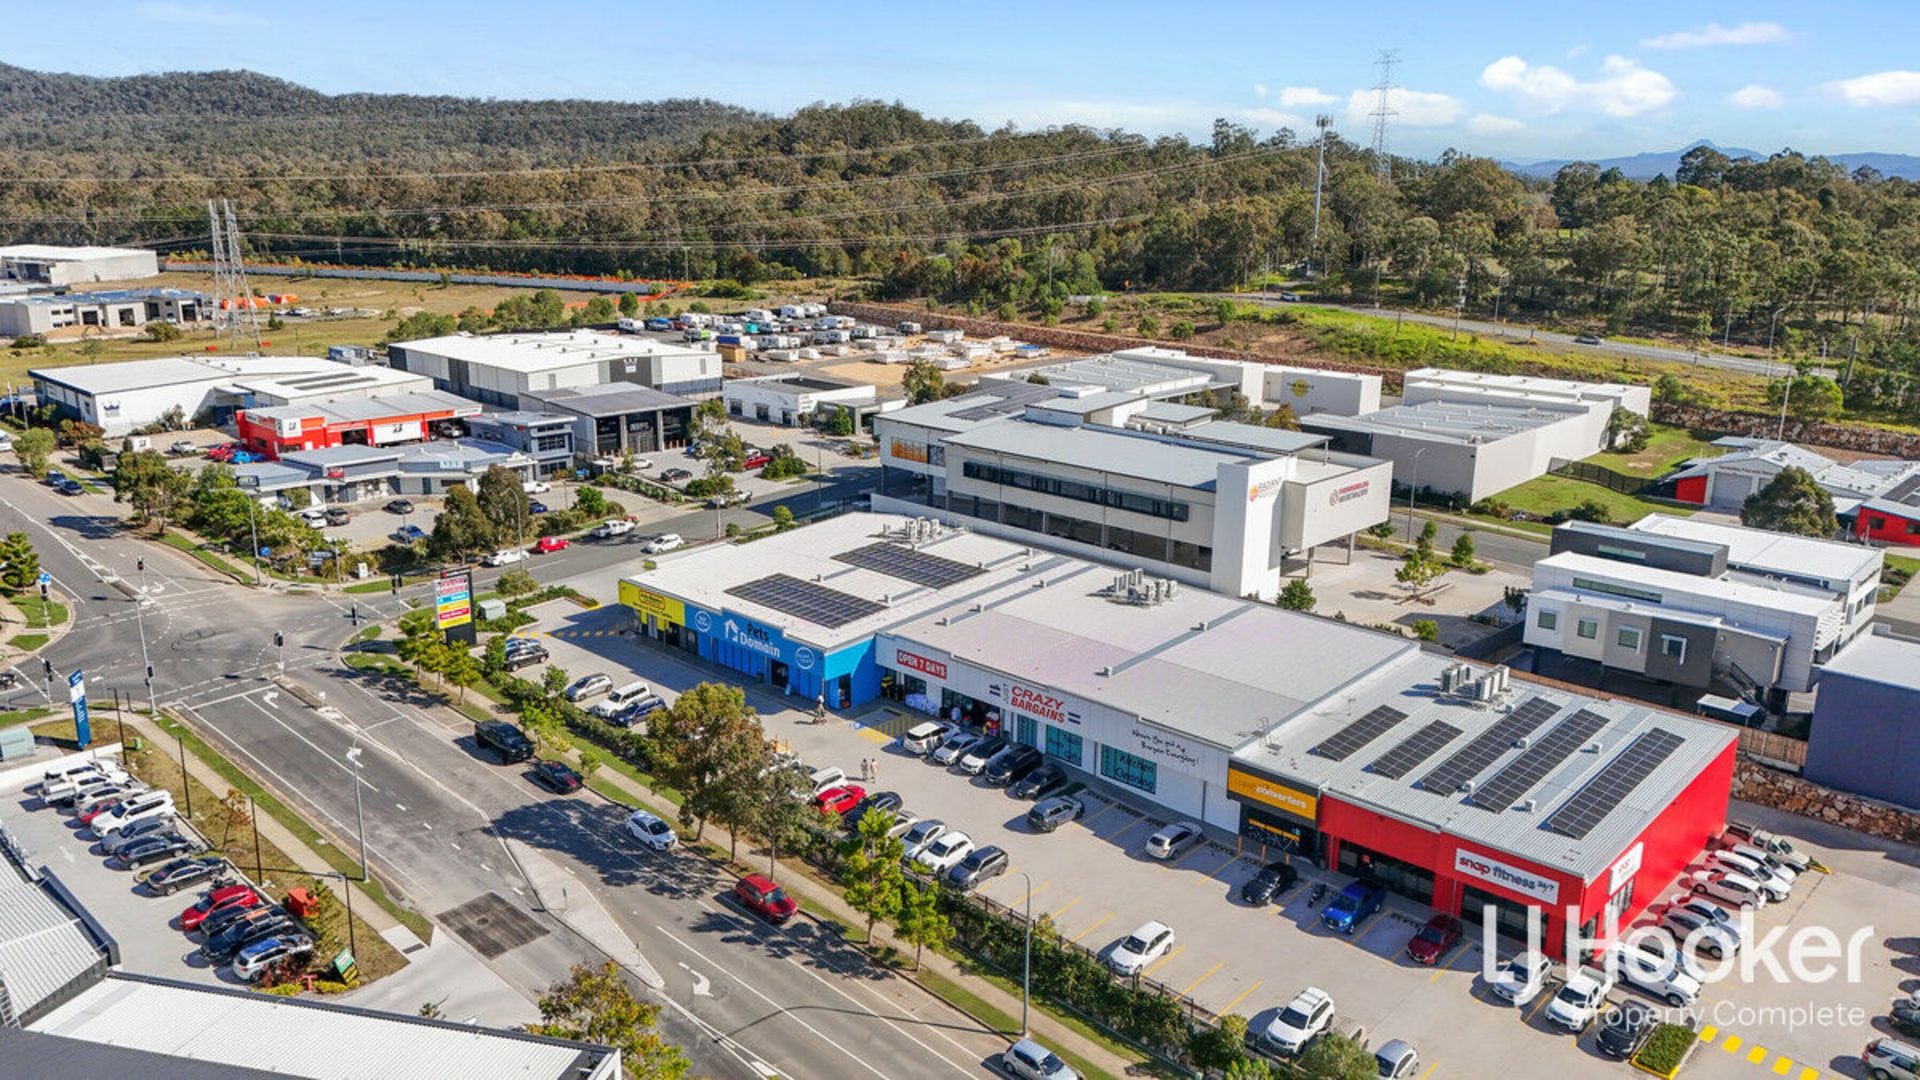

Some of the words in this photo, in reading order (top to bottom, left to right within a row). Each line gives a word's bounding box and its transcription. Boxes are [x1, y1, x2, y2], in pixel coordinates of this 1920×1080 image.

[740, 632, 780, 658] Domain
[747, 622, 769, 642] Pets
[898, 651, 918, 668] OPEN
[919, 658, 925, 669] 7
[926, 660, 946, 677] DAYS
[1011, 686, 1064, 710] CRAZY
[1011, 696, 1066, 723] BARGAINS
[1255, 786, 1307, 809] converters
[1459, 857, 1490, 875] snap
[1493, 865, 1535, 889] fitness
[1537, 881, 1554, 893] 24/7
